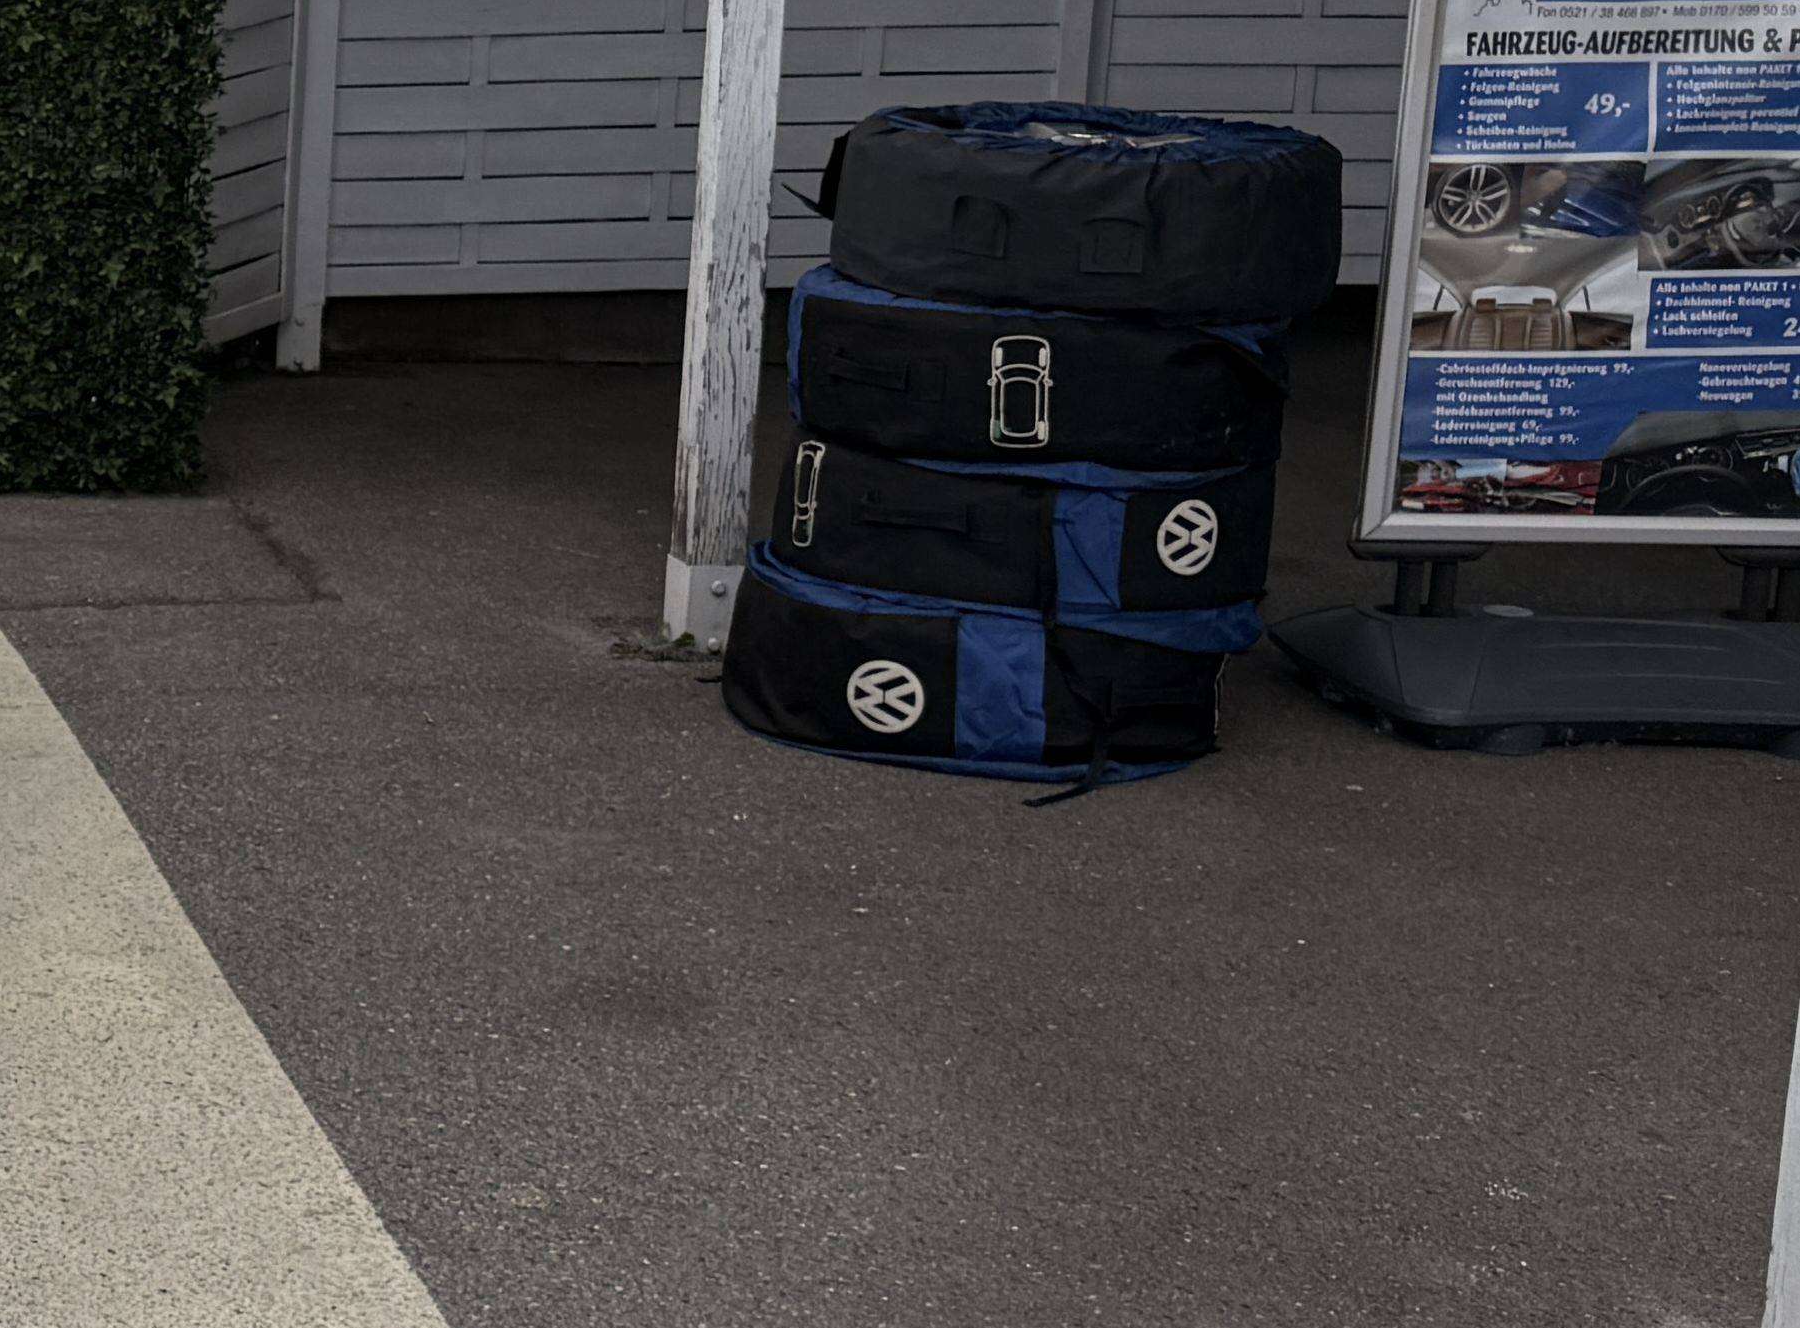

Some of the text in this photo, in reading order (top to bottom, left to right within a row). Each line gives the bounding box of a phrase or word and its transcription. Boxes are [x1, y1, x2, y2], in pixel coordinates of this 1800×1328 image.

[1466, 29, 1754, 57] FAHRZEUG-AUFBEREITUNG
[1763, 28, 1783, 53] &
[1584, 92, 1631, 117] 49,-
